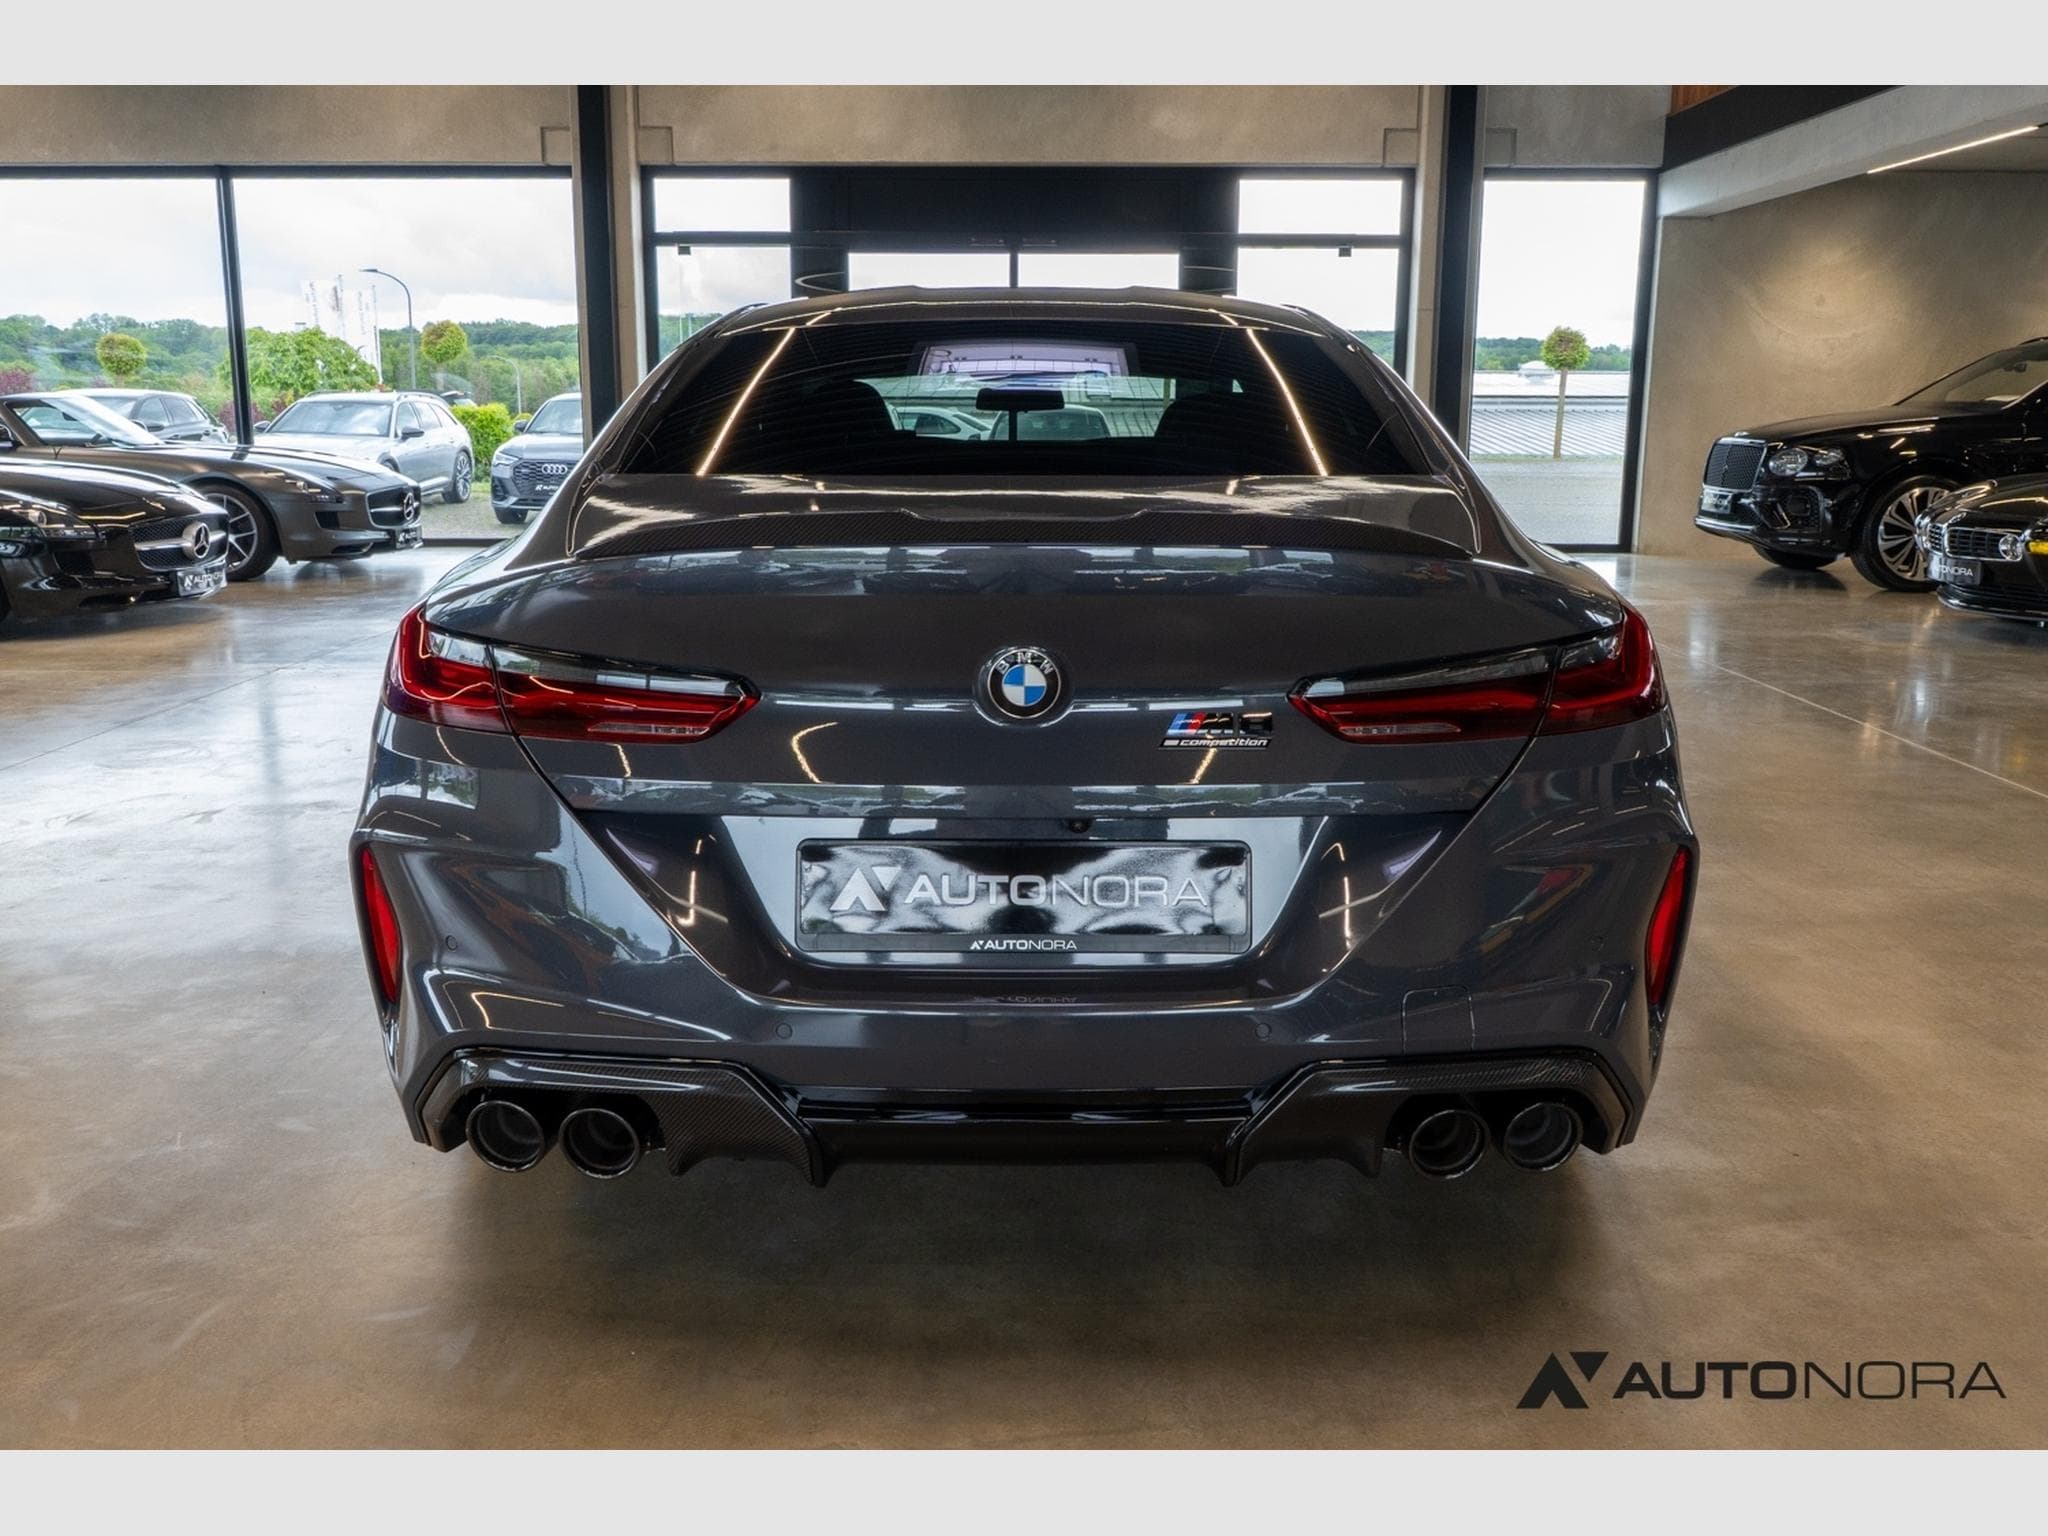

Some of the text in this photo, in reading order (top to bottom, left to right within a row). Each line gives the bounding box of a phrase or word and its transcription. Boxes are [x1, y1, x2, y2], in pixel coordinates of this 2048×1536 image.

[995, 652, 1054, 675] BMW
[1179, 738, 1268, 747] competition
[904, 873, 1208, 907] AUTONORA
[984, 939, 1077, 950] AUTONORA
